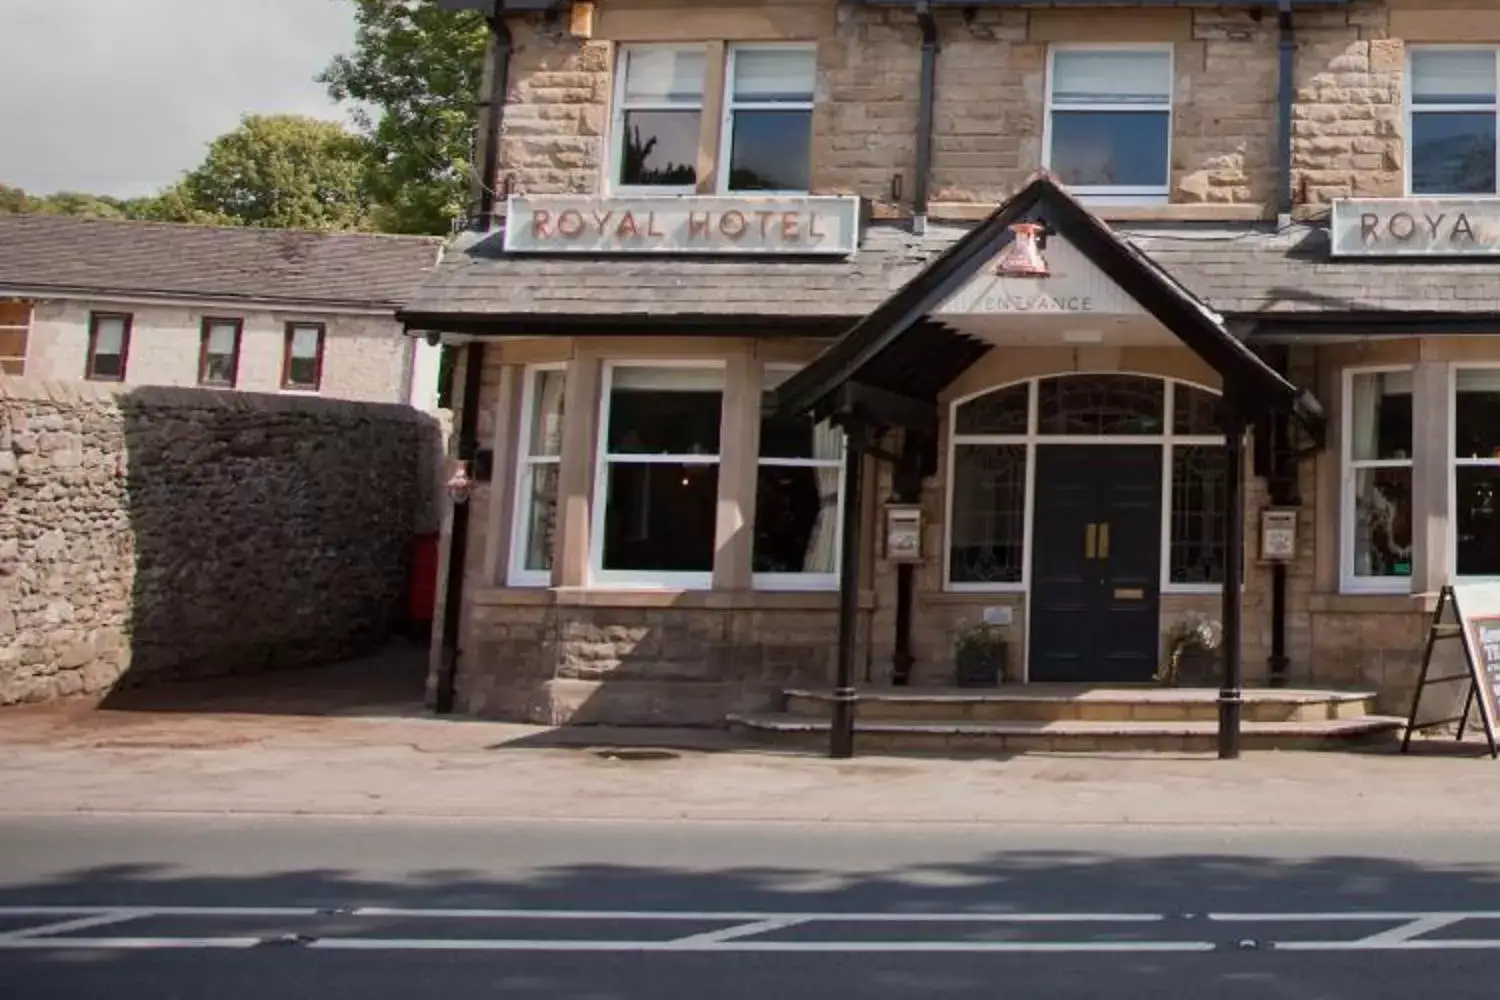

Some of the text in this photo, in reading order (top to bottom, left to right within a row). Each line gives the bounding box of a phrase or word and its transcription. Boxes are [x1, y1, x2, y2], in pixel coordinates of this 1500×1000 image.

[531, 209, 827, 239] ROYAL HOTEL
[1360, 212, 1478, 241] ROYA
